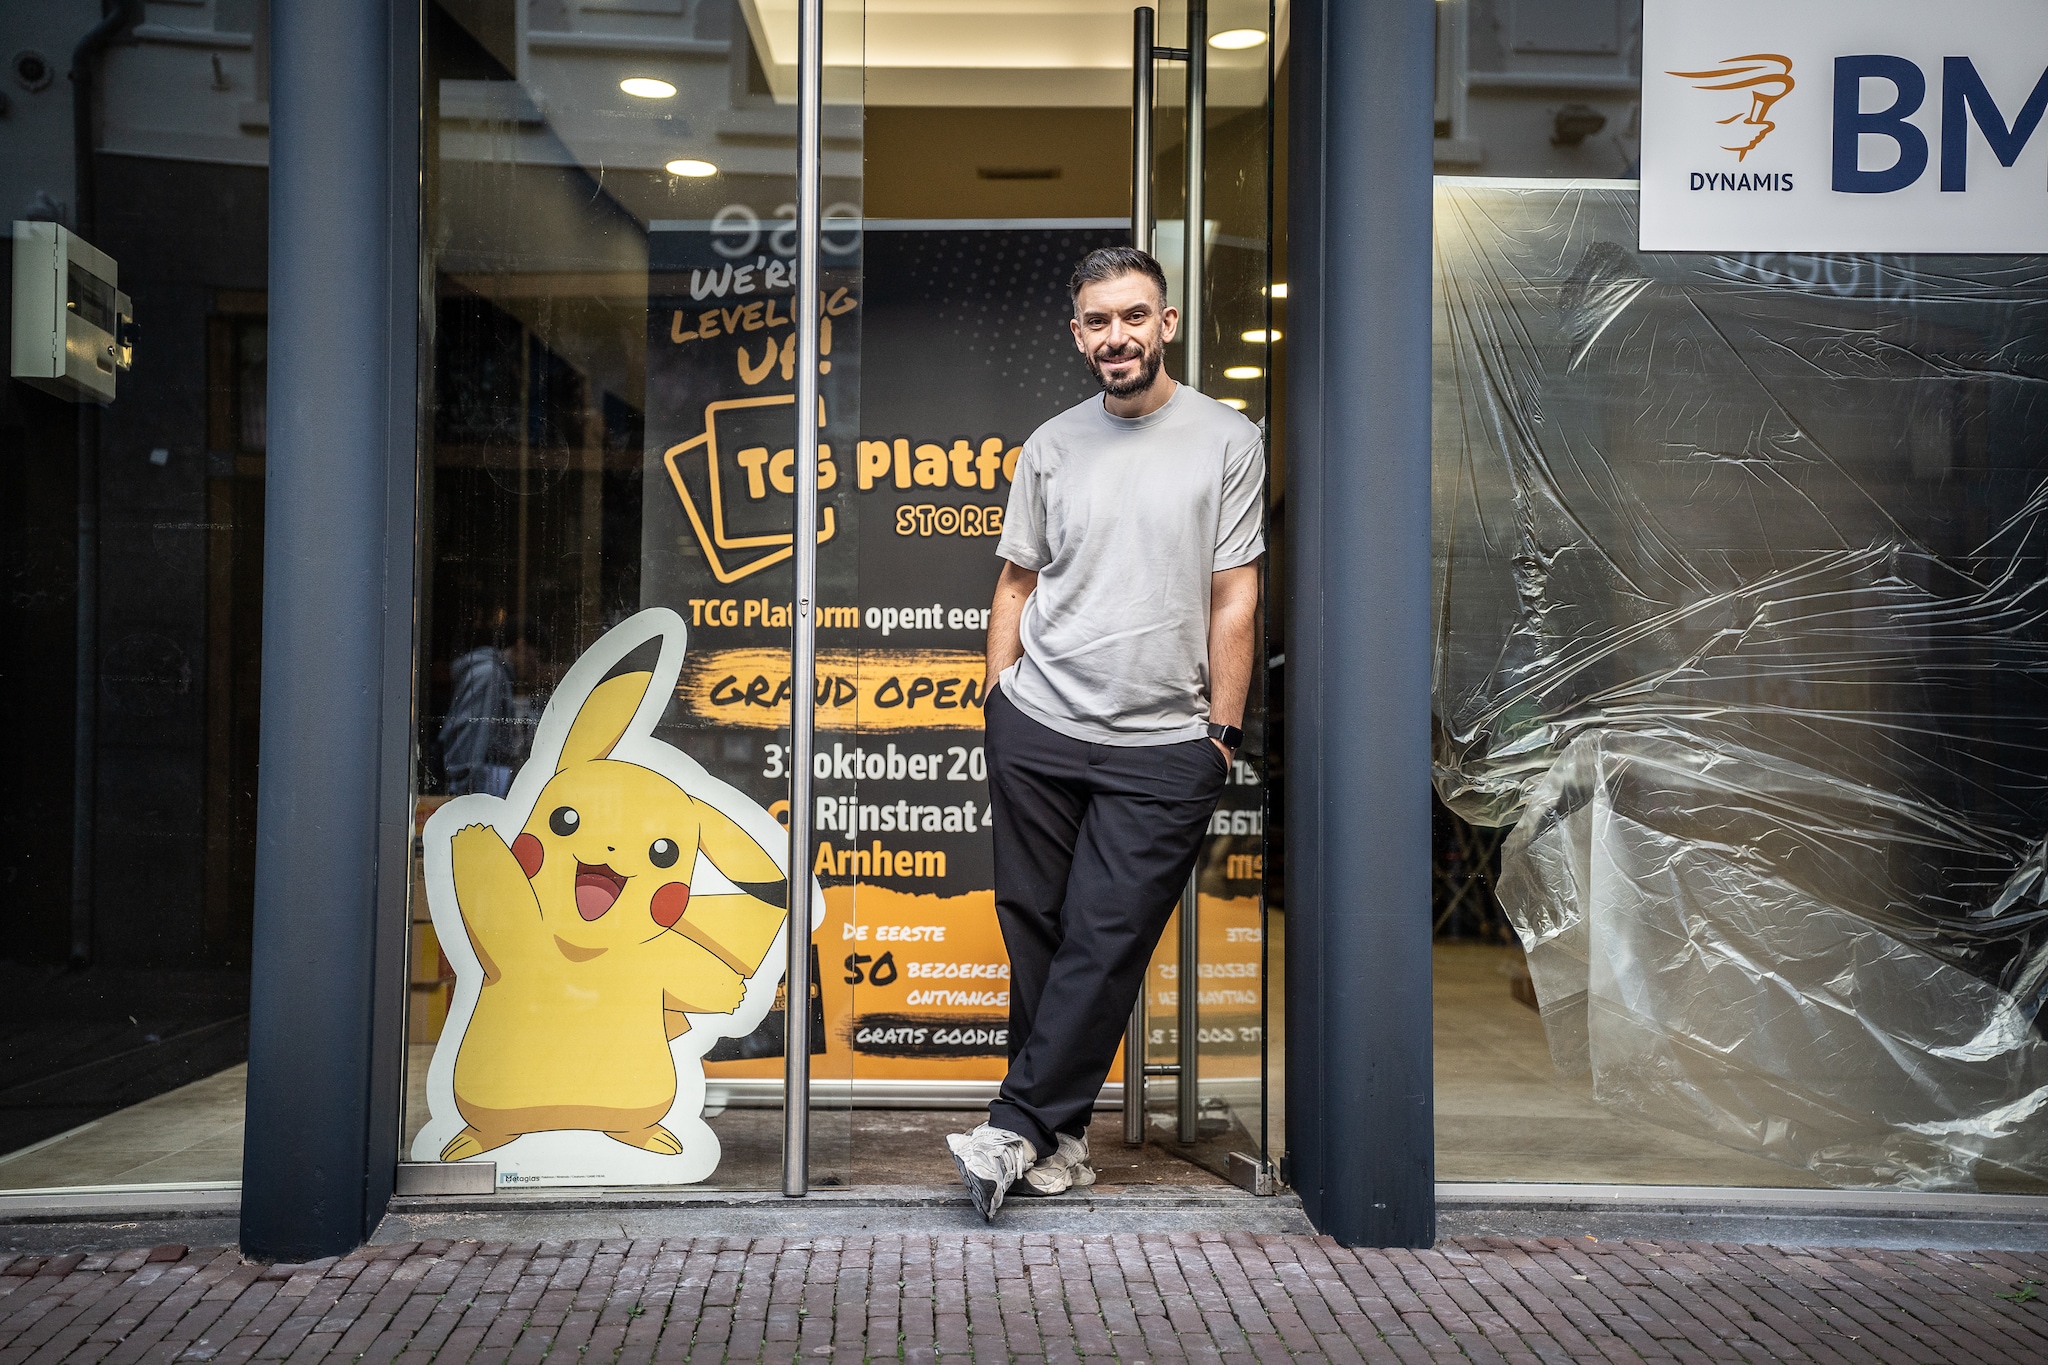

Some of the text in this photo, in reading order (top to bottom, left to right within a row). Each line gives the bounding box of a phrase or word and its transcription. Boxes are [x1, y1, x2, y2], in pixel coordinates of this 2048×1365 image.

[1690, 171, 1794, 192] DYNAMIS
[895, 504, 1003, 537] STORE
[688, 599, 738, 627] TCG
[865, 603, 943, 637] opent
[813, 742, 943, 781] oktober
[816, 796, 978, 841] Rijnstraat
[813, 840, 947, 877] Arnhem
[842, 922, 946, 942] DE EERSTE
[844, 951, 898, 987] 50
[906, 989, 1010, 1006] ONTVANGE
[856, 1027, 929, 1044] GRATIS
